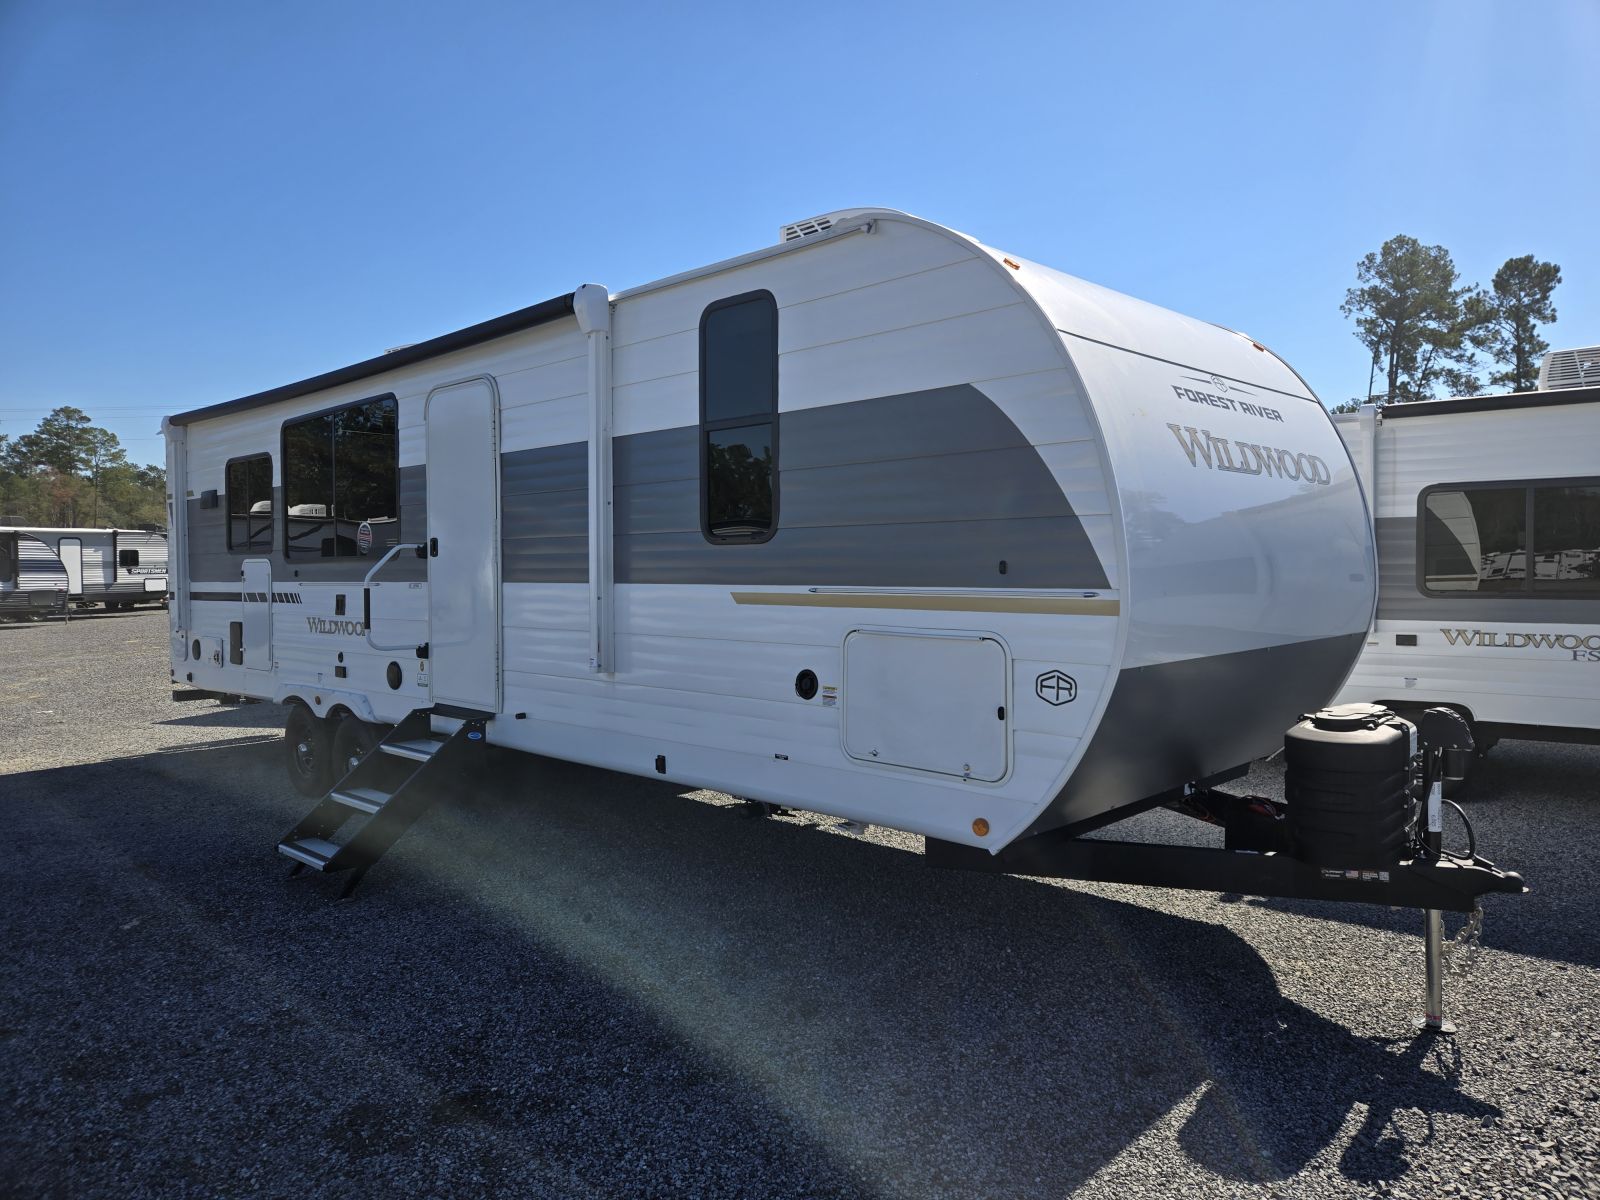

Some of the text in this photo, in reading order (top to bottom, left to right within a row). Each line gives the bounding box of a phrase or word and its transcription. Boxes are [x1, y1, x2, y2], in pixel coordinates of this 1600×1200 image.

[1171, 384, 1285, 423] FOREST RIVER
[1166, 422, 1332, 486] WILDWOOD
